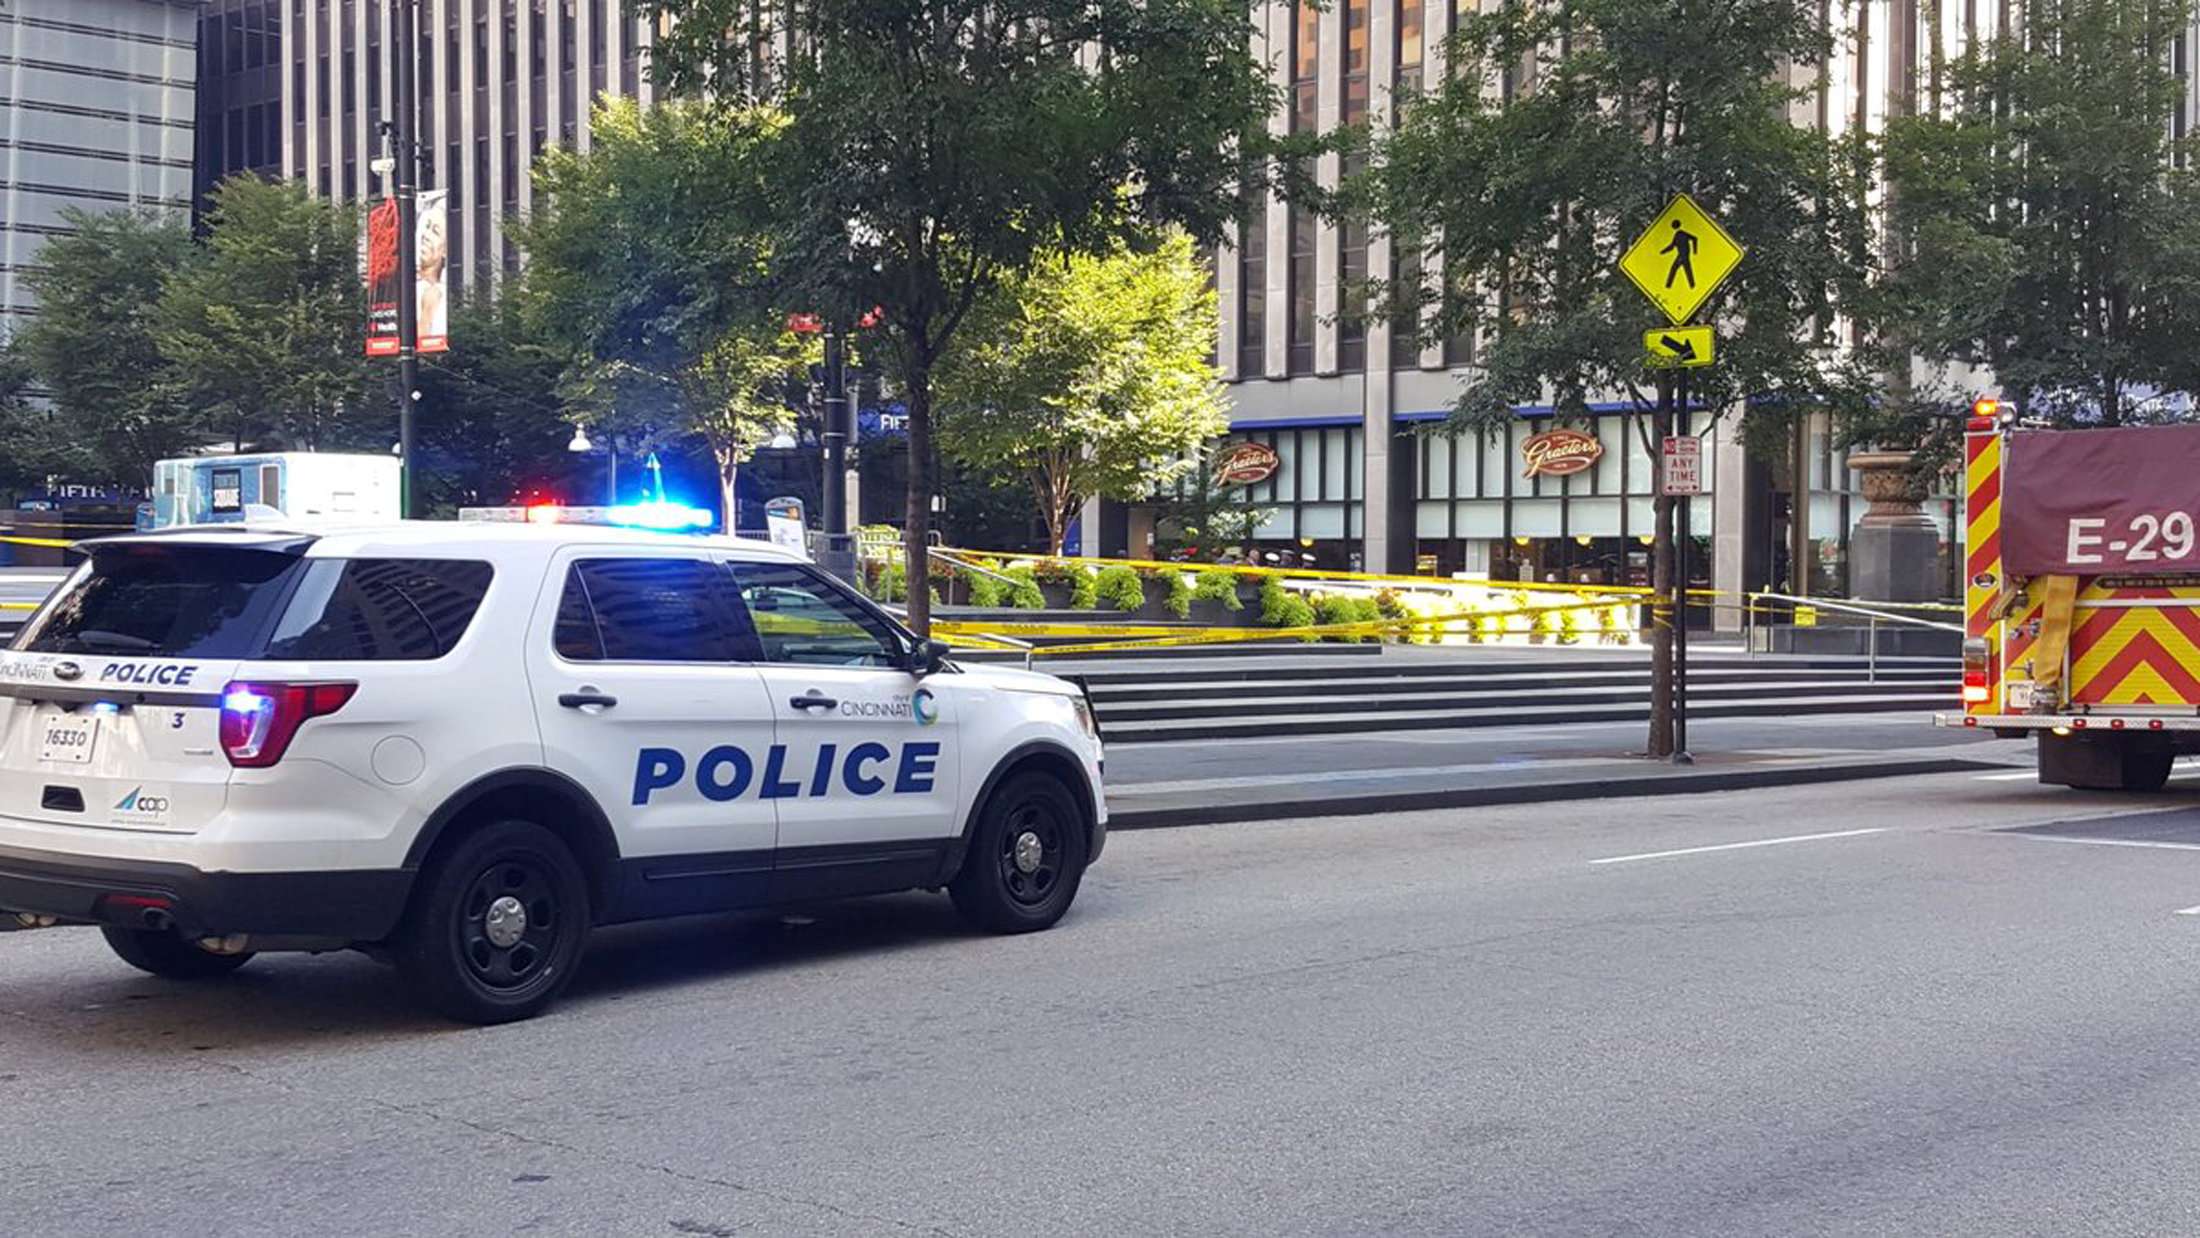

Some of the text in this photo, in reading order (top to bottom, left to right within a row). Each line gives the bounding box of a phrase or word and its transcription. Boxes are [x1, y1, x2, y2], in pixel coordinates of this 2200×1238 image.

[1672, 459, 1694, 468] ANY
[1671, 471, 1697, 482] TIME
[2066, 511, 2195, 564] E-29
[100, 663, 198, 686] POLICE
[841, 700, 912, 717] CINCINNATI
[172, 712, 186, 729] 3
[45, 729, 87, 746] 16330
[631, 742, 941, 806] POLICE
[137, 797, 169, 819] cap
